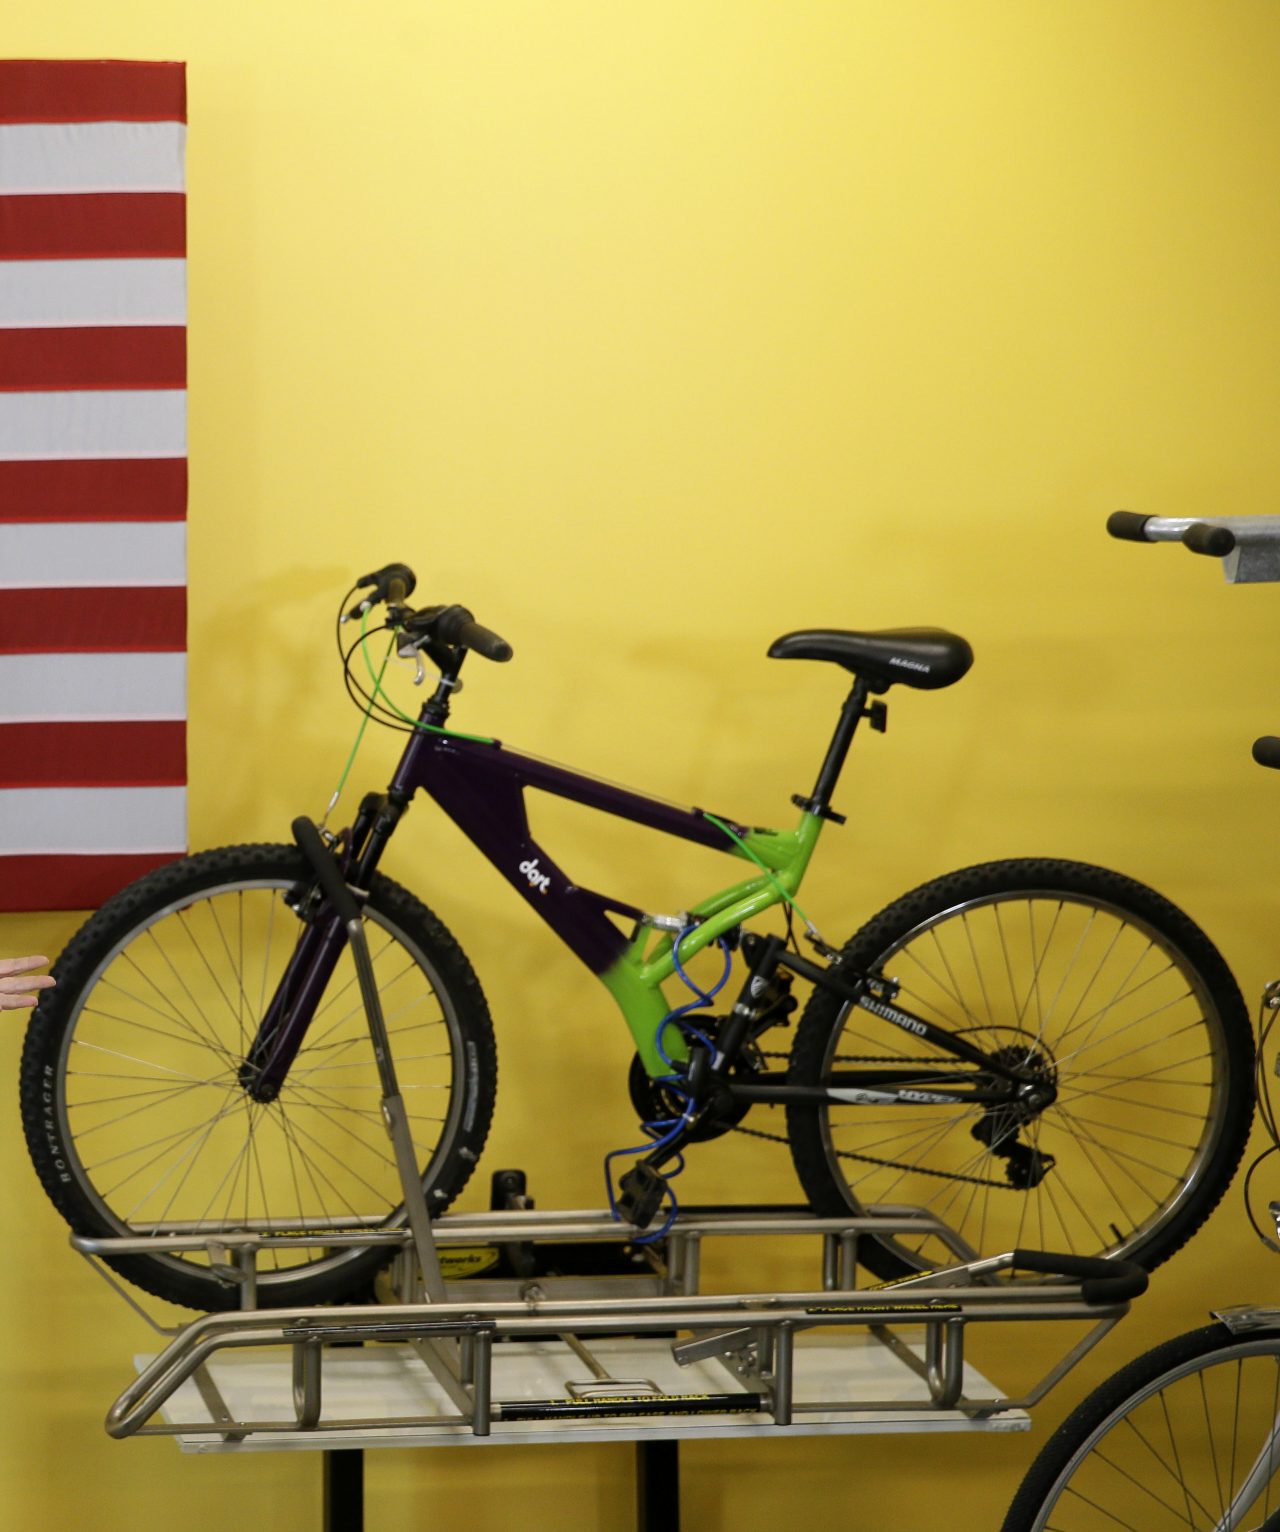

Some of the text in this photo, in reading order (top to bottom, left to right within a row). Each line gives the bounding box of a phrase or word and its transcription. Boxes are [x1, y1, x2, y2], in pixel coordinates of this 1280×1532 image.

[889, 657, 930, 673] MAGNA
[519, 858, 551, 895] dart
[860, 996, 928, 1036] SHIMANO
[42, 1064, 72, 1183] BONTRAGER
[637, 1395, 650, 1403] TO
